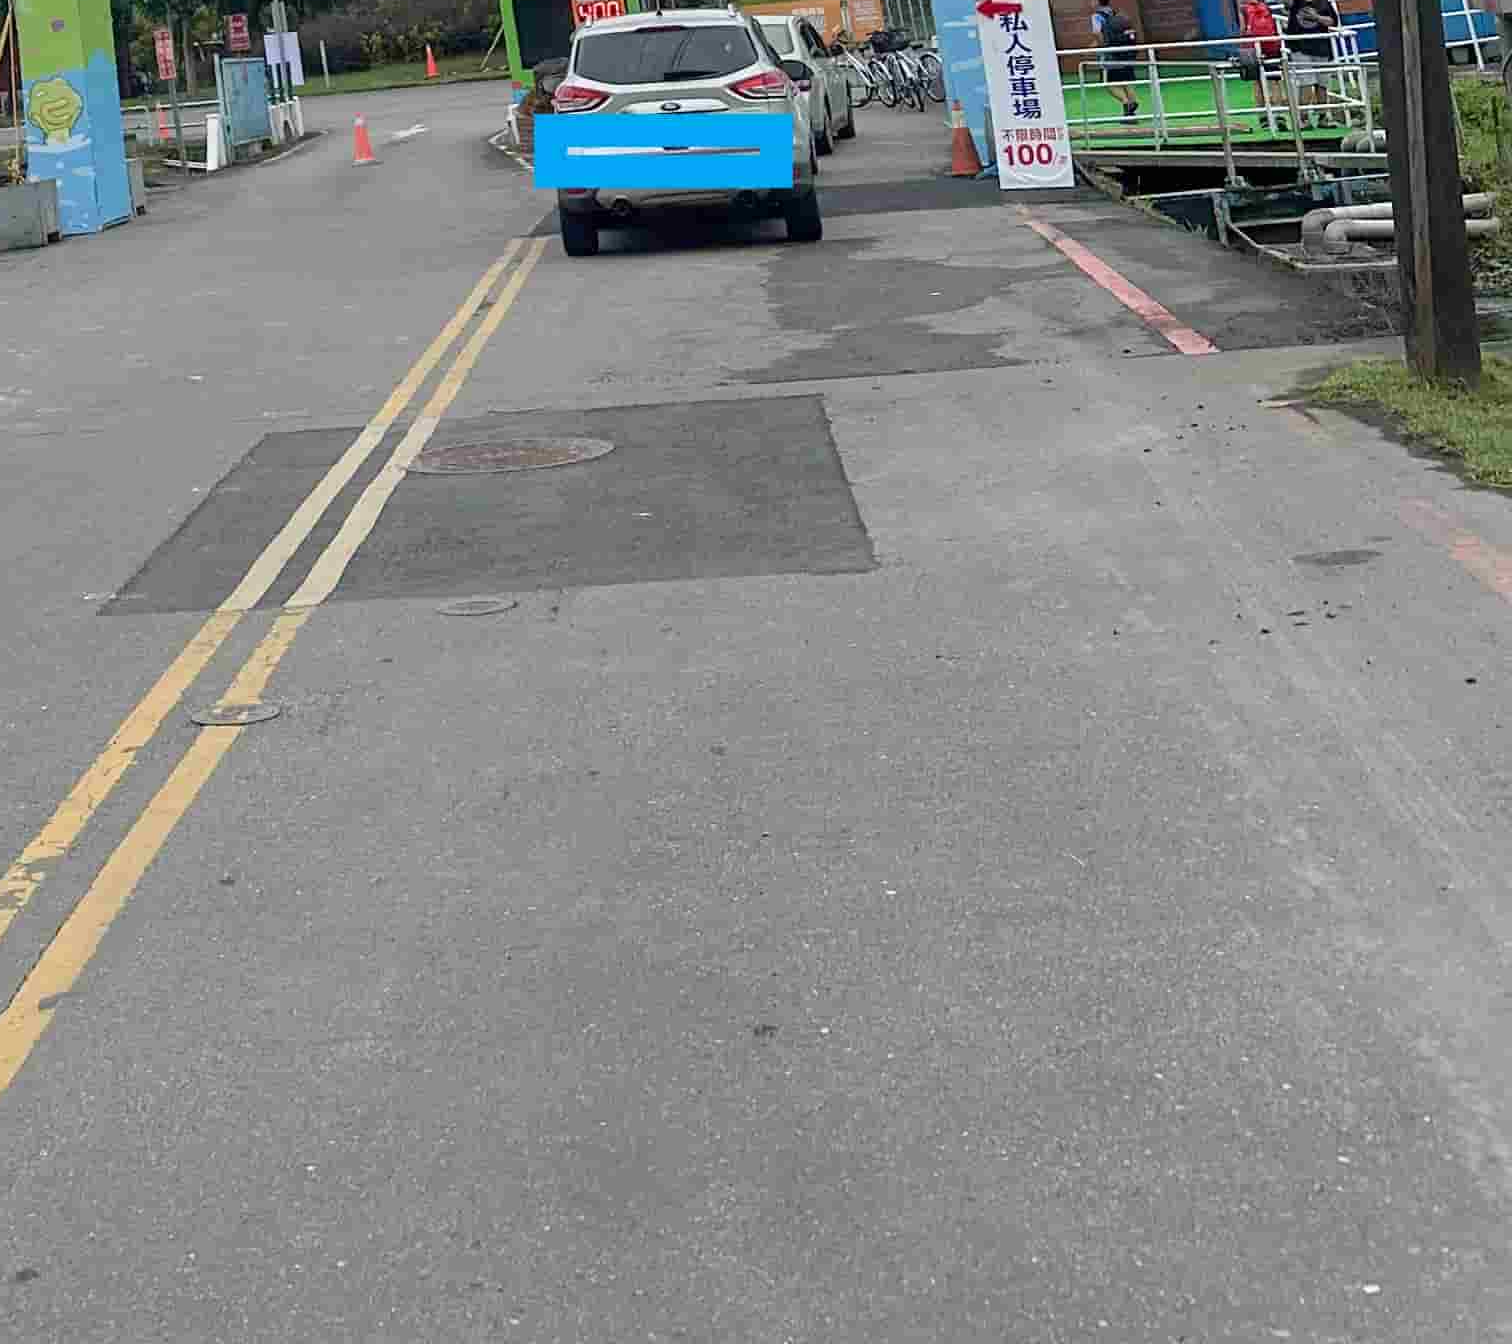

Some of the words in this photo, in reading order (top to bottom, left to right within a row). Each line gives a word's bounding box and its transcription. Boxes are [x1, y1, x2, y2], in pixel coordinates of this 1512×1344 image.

[999, 13, 1042, 119] 私人停車場
